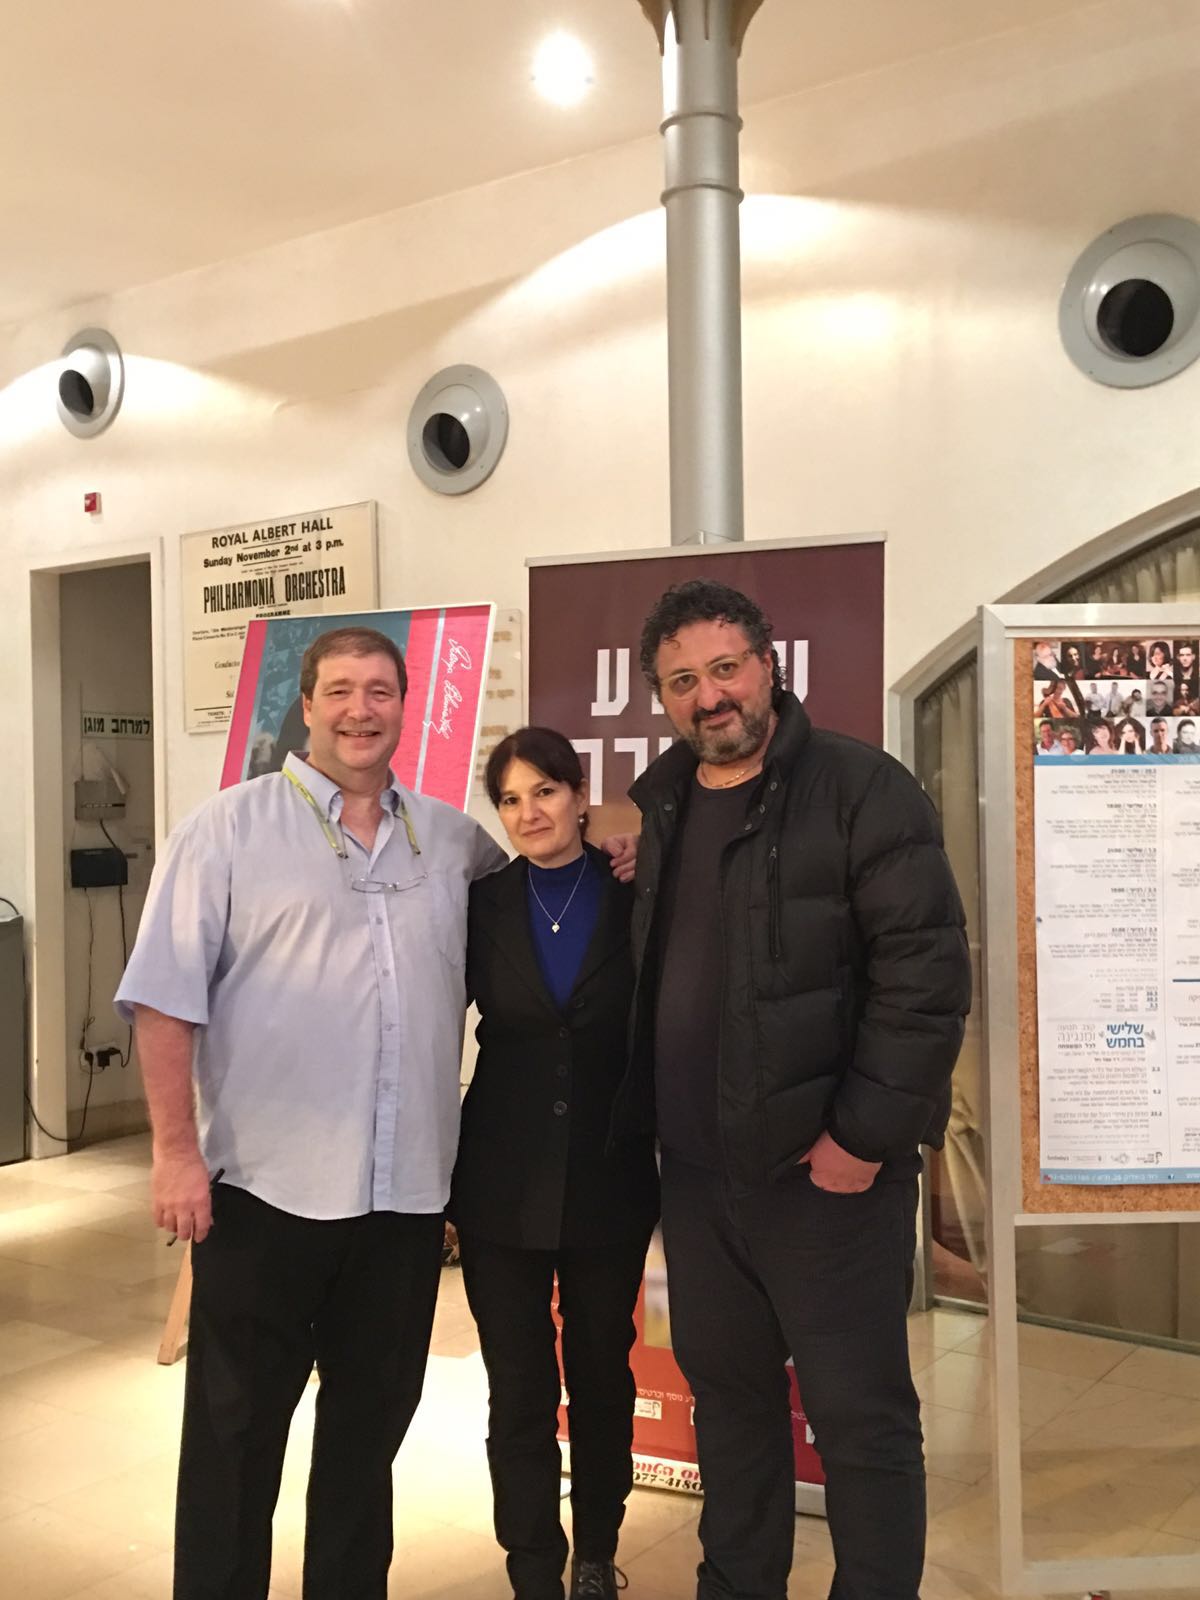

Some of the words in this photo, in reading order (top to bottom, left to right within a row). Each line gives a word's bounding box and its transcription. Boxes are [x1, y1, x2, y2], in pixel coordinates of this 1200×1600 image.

[212, 532, 248, 549] ROYAL
[252, 523, 297, 541] ALBERT
[301, 517, 333, 533] HALL
[203, 556, 233, 568] Sunday
[236, 548, 280, 563] November
[284, 544, 299, 555] 2nd
[302, 542, 312, 552] at
[315, 540, 322, 550] 3
[325, 538, 344, 550] p.m.
[203, 577, 275, 614] PHILHARMONIA
[284, 566, 346, 602] ORCHESTRA
[255, 610, 291, 618] PROGRAMME
[215, 660, 241, 669] Conducto
[83, 717, 104, 734] מוגן
[112, 718, 150, 734] למרחב
[1106, 1021, 1144, 1035] שלישי
[1057, 1032, 1096, 1043] ומנגינה
[1106, 1037, 1145, 1048] בחמש
